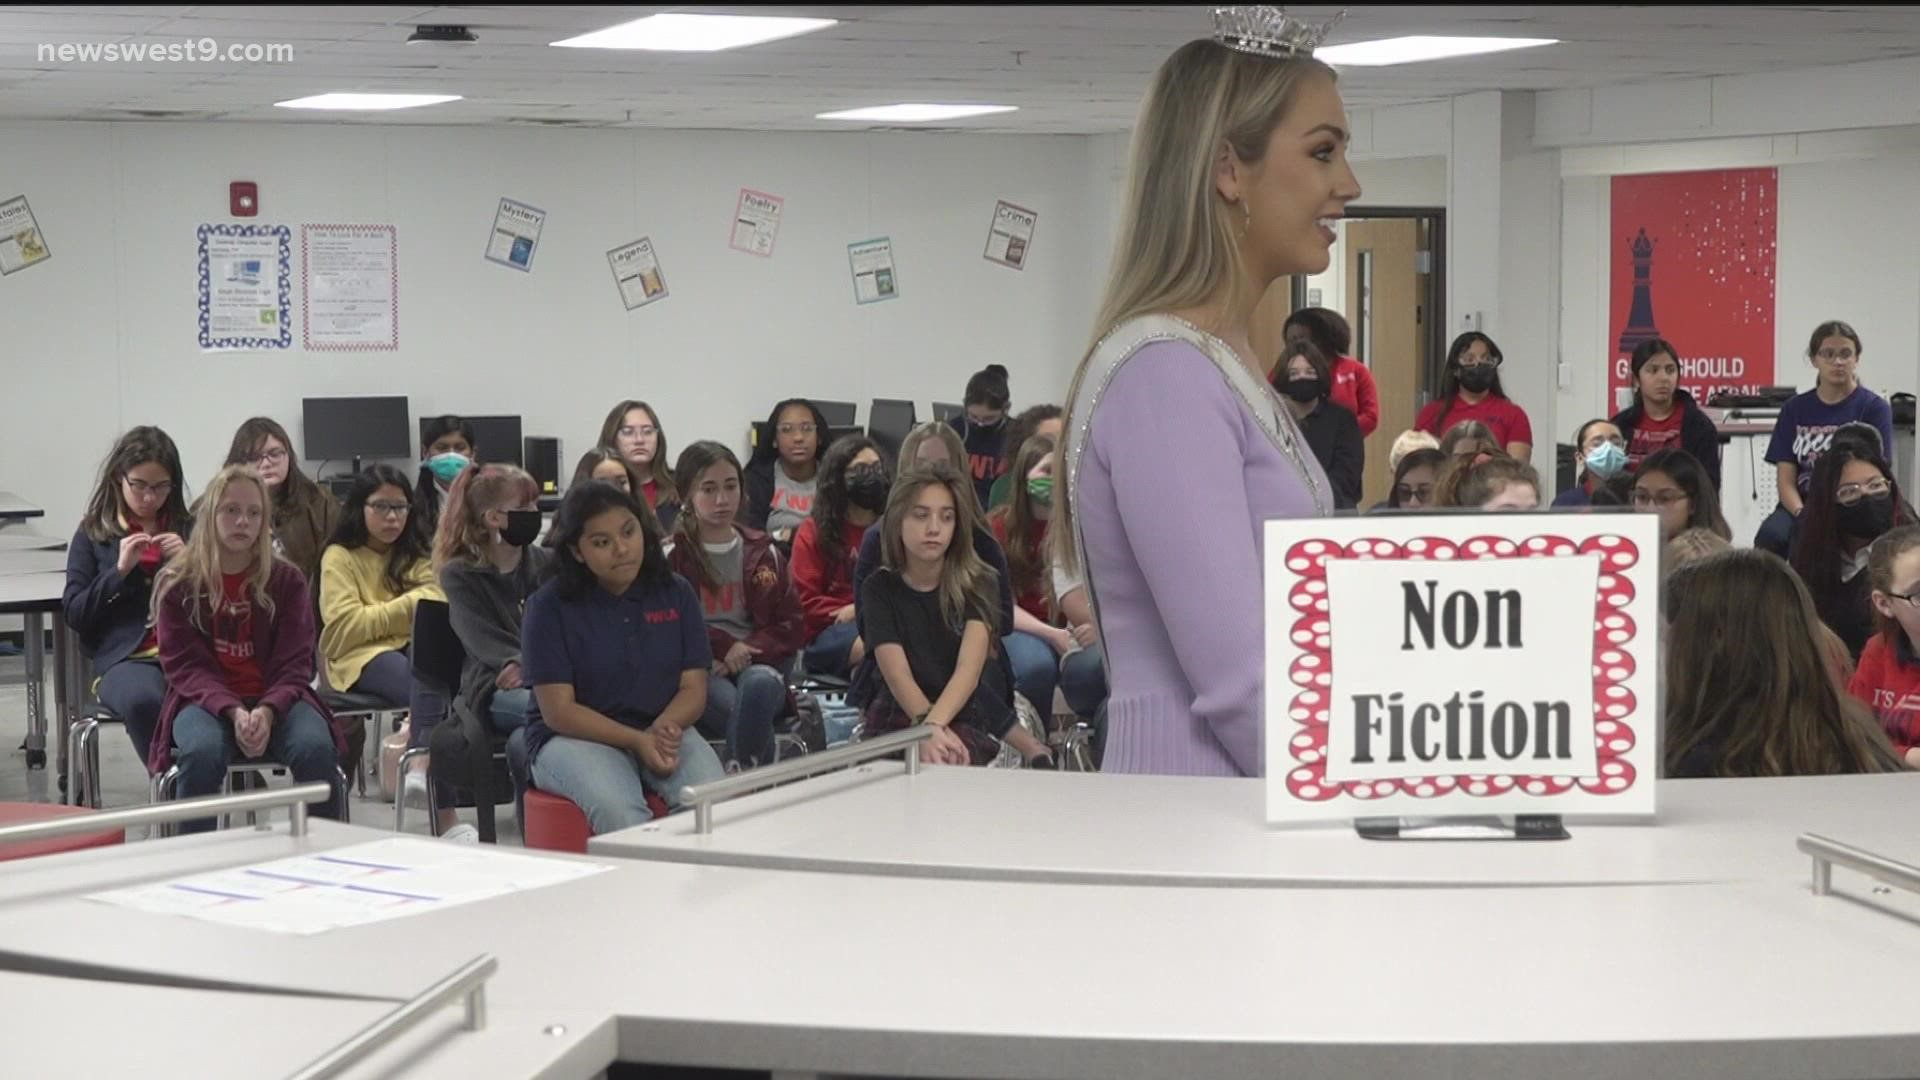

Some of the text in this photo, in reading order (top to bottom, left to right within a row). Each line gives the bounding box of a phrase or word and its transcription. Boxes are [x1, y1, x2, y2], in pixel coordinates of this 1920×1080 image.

[503, 203, 541, 223] Mystery
[744, 193, 778, 213] Poetry
[999, 207, 1032, 226] Crime
[612, 243, 649, 263] Legend
[1400, 580, 1523, 650] Non
[1350, 690, 1572, 764] Fiction
